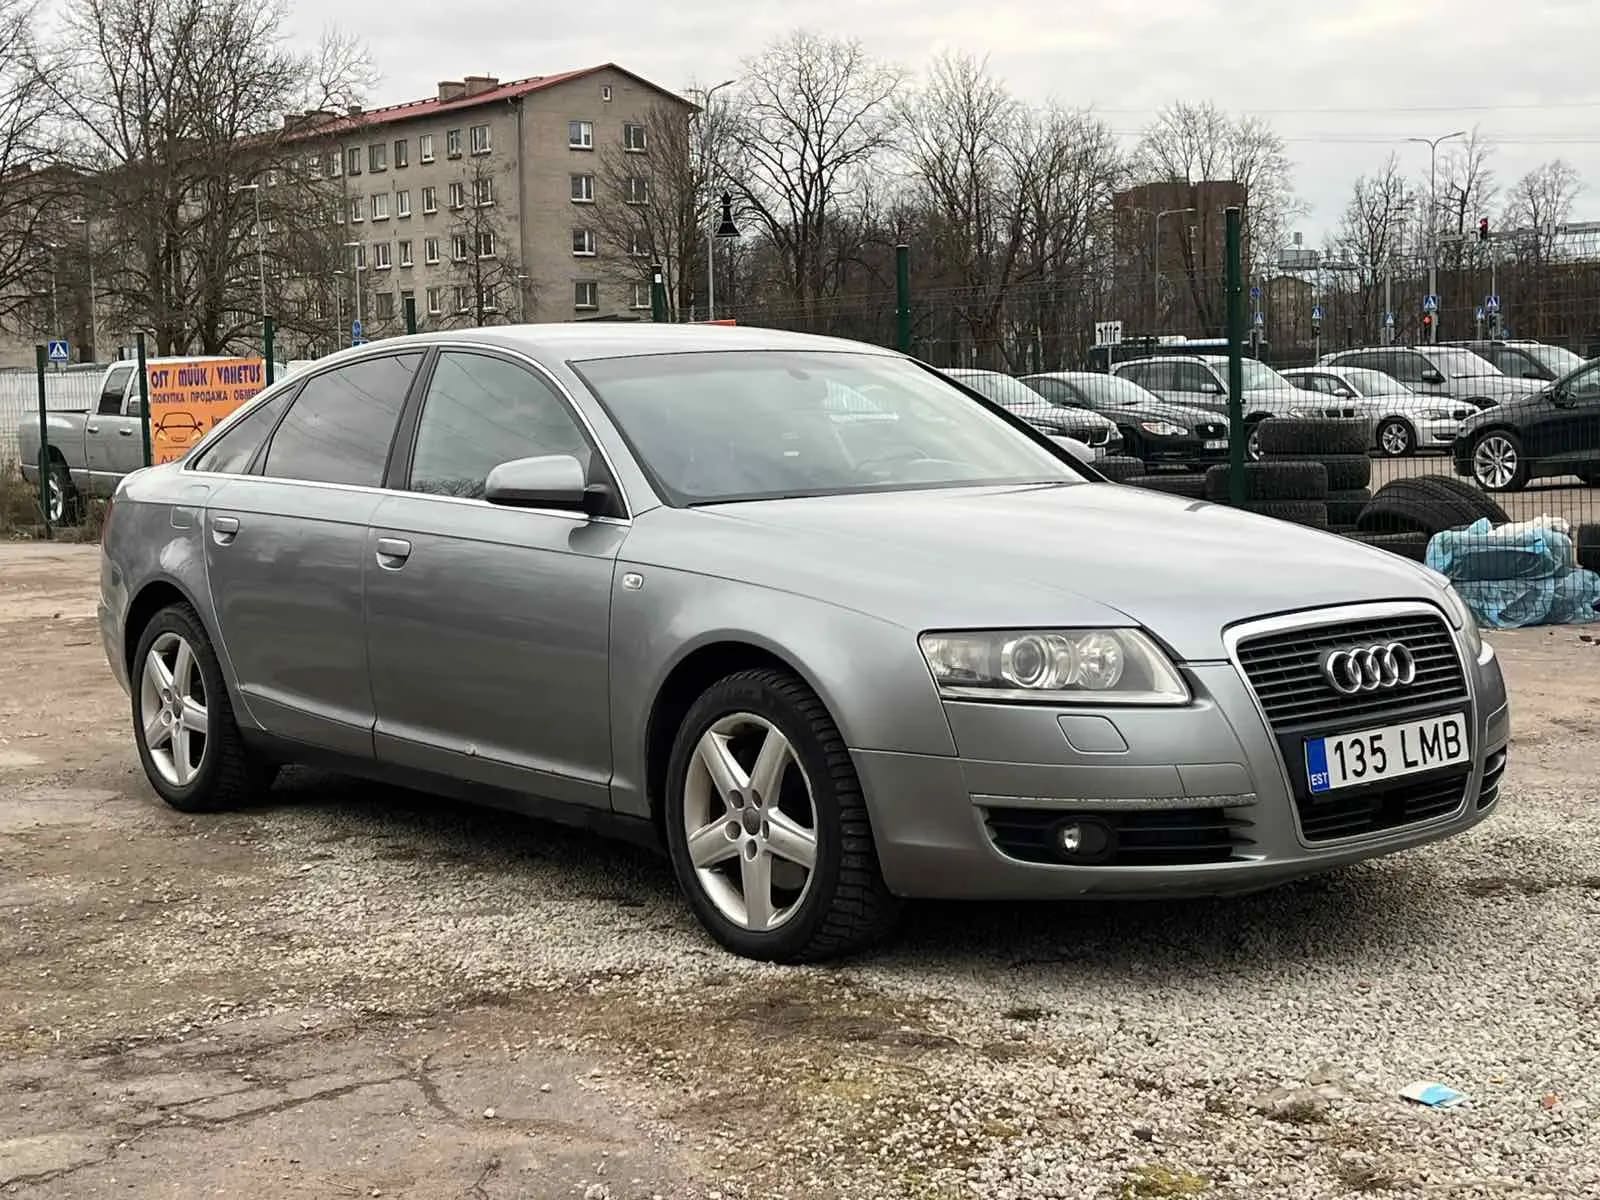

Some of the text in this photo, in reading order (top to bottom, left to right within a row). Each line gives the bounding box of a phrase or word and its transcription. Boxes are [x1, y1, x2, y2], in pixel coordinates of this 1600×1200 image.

[151, 370, 168, 389] OST
[178, 363, 207, 387] MÜÜK
[216, 364, 261, 385] VAHETUS
[152, 392, 185, 404] ПОКУПКА
[190, 390, 228, 404] ПРОДАЖА
[1334, 720, 1462, 781] 135 LMB
[1311, 772, 1329, 786] EST
